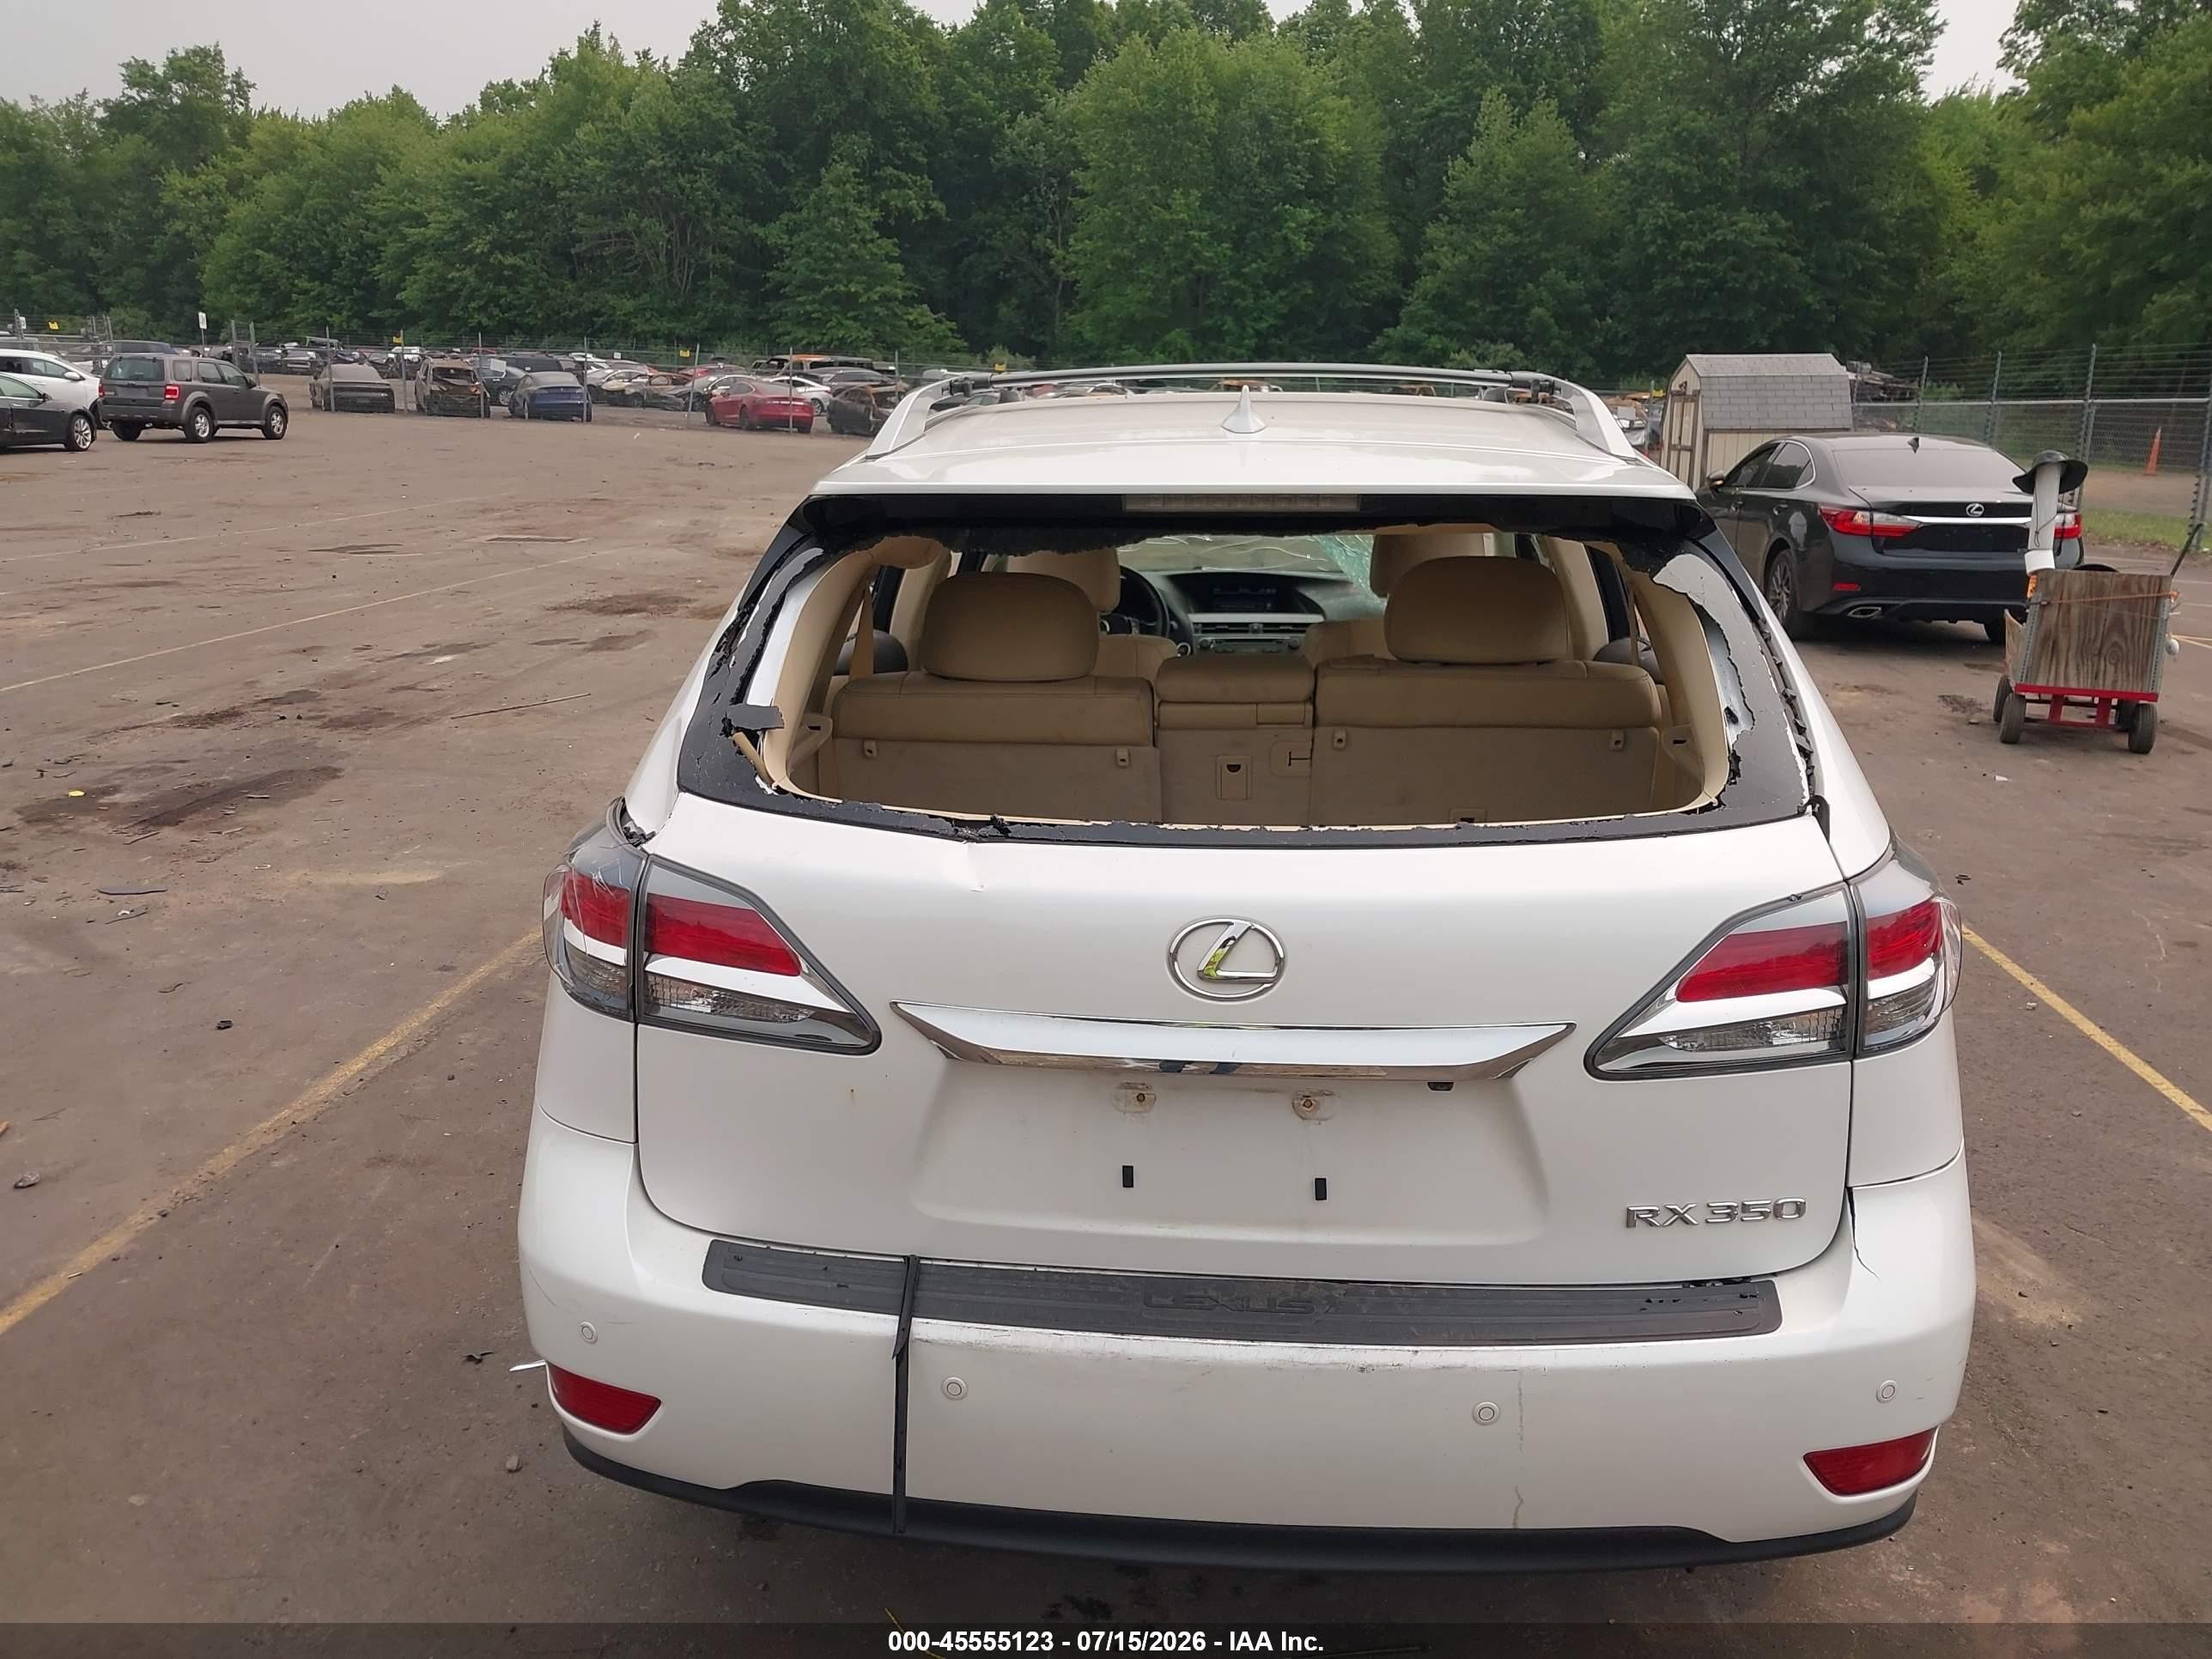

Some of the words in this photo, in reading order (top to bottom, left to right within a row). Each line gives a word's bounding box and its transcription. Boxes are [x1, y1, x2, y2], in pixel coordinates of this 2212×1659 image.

[1626, 1202, 1699, 1228] RX
[1705, 1197, 1807, 1223] 350
[1142, 1290, 1316, 1315] LEXUS
